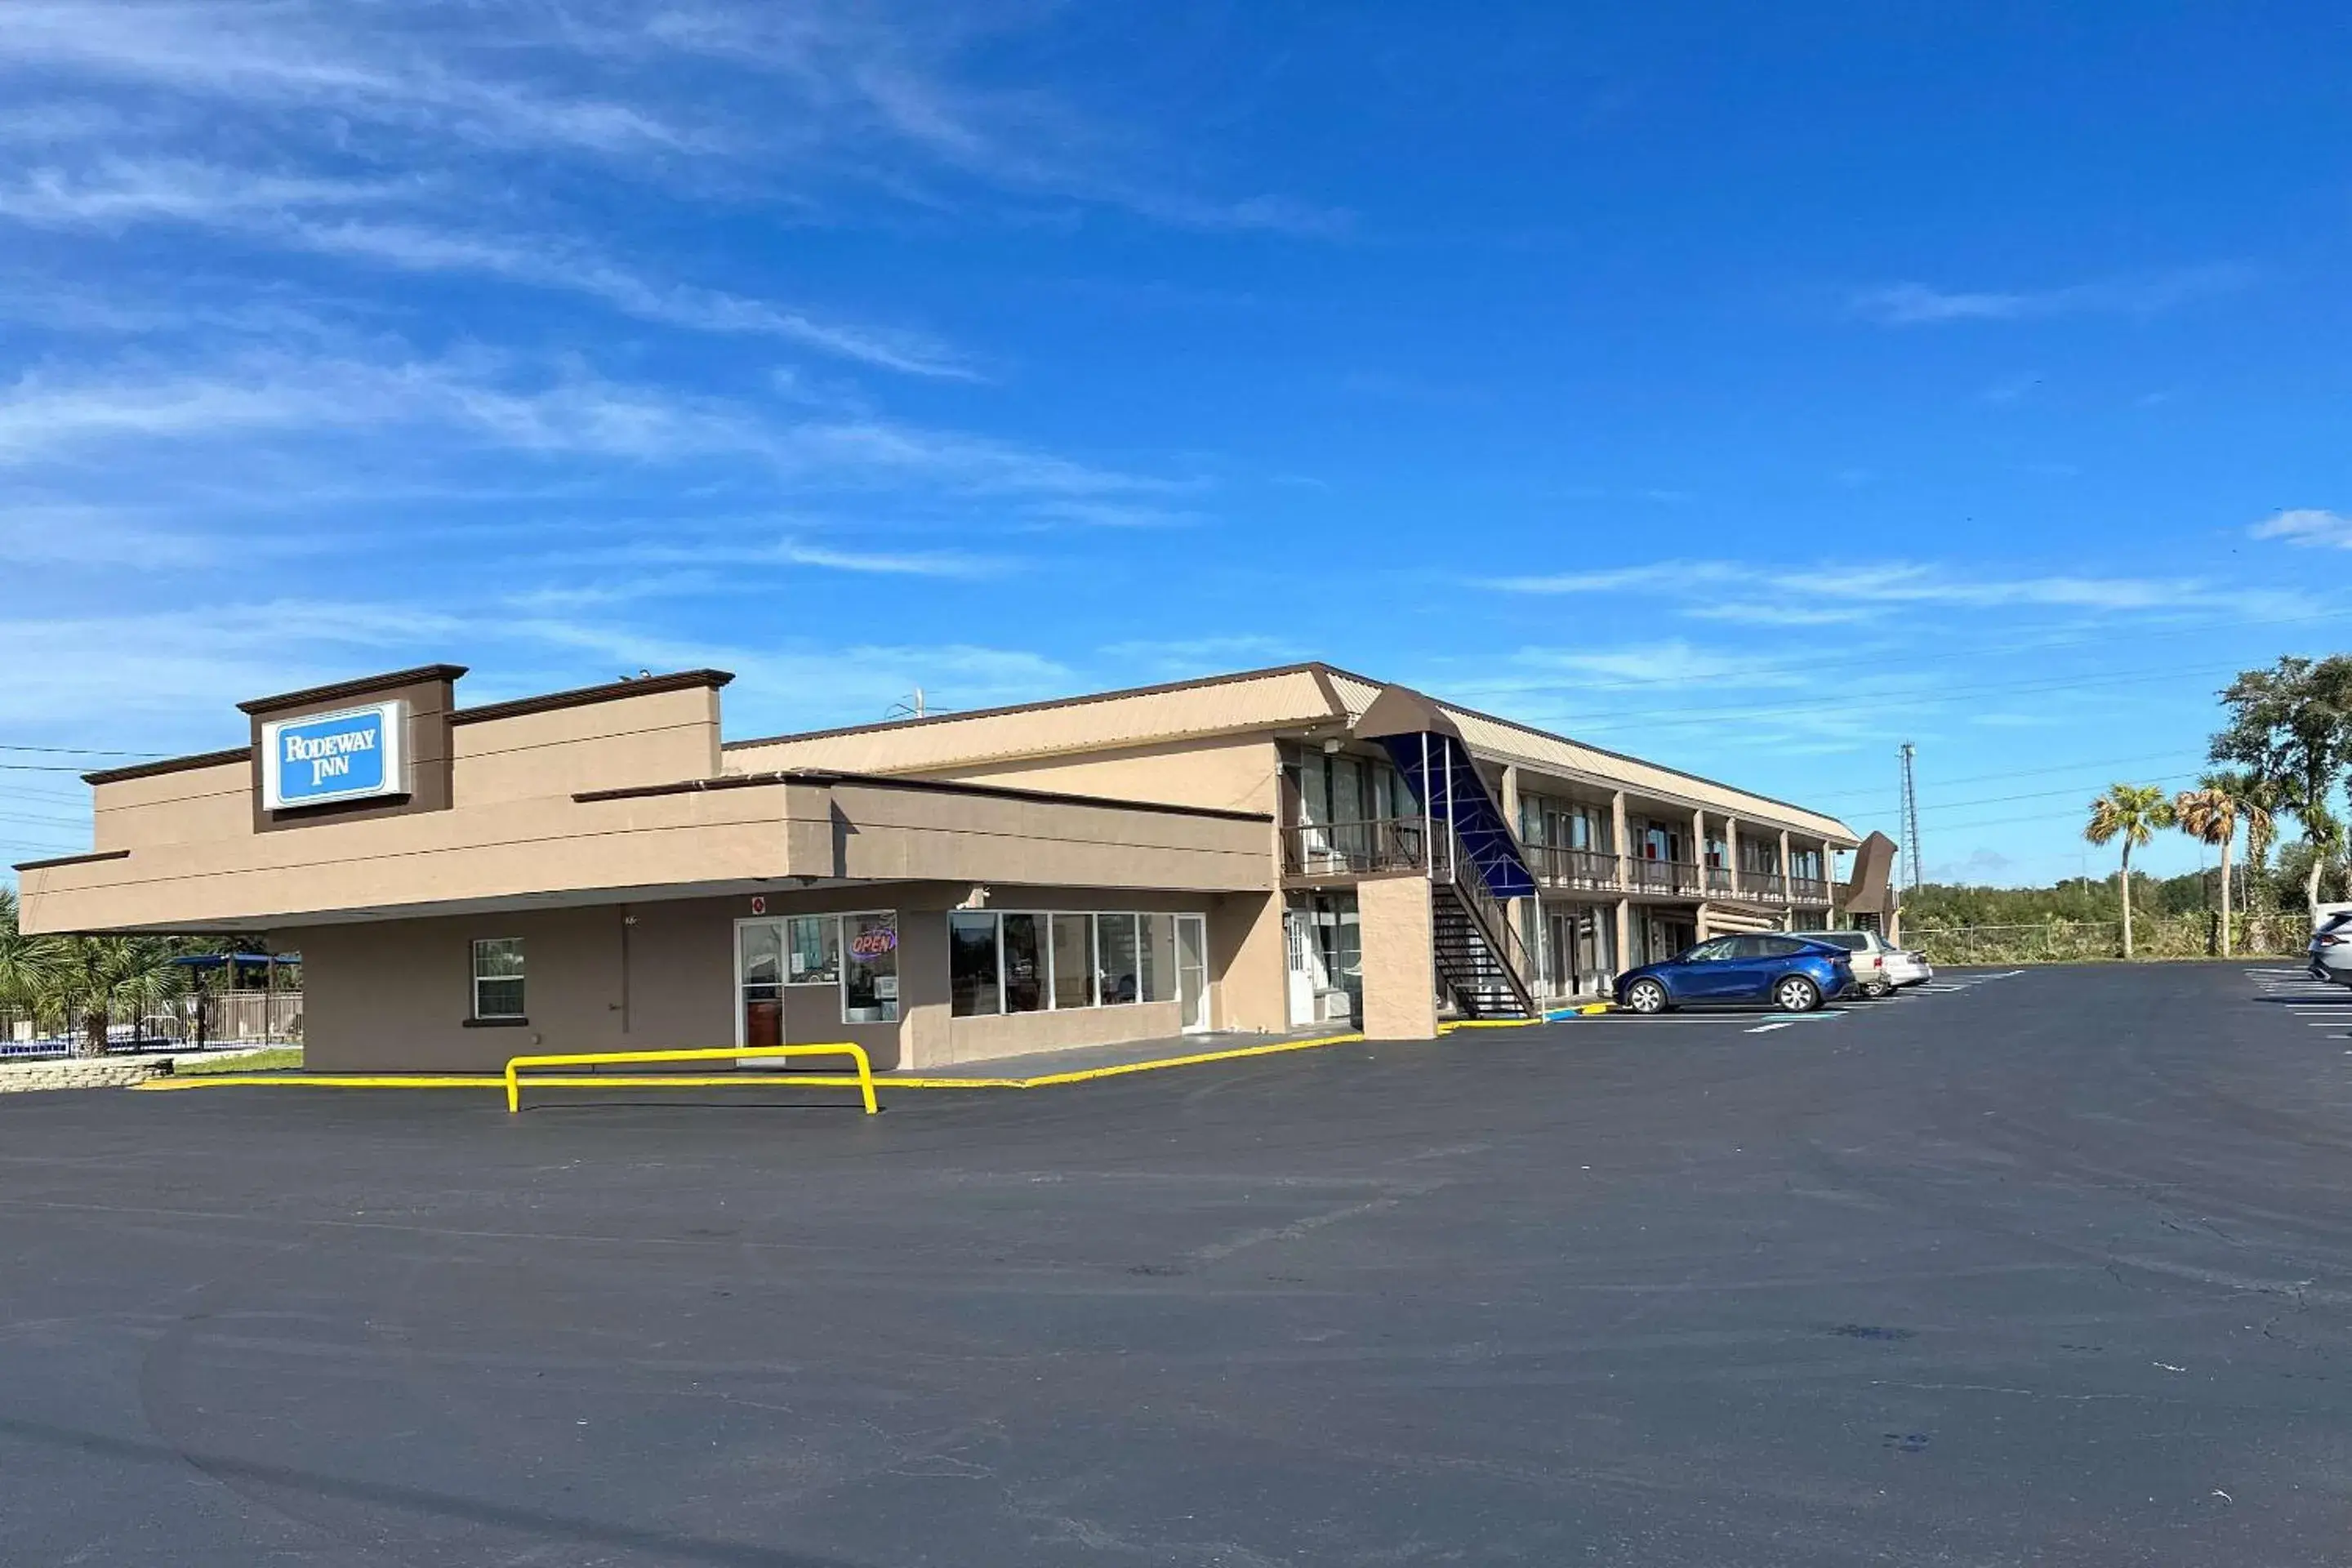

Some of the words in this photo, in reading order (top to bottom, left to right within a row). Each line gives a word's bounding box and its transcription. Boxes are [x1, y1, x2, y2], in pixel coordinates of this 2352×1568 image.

[286, 729, 376, 762] RODEWAY
[312, 755, 349, 785] INN
[852, 936, 889, 952] OPEN
